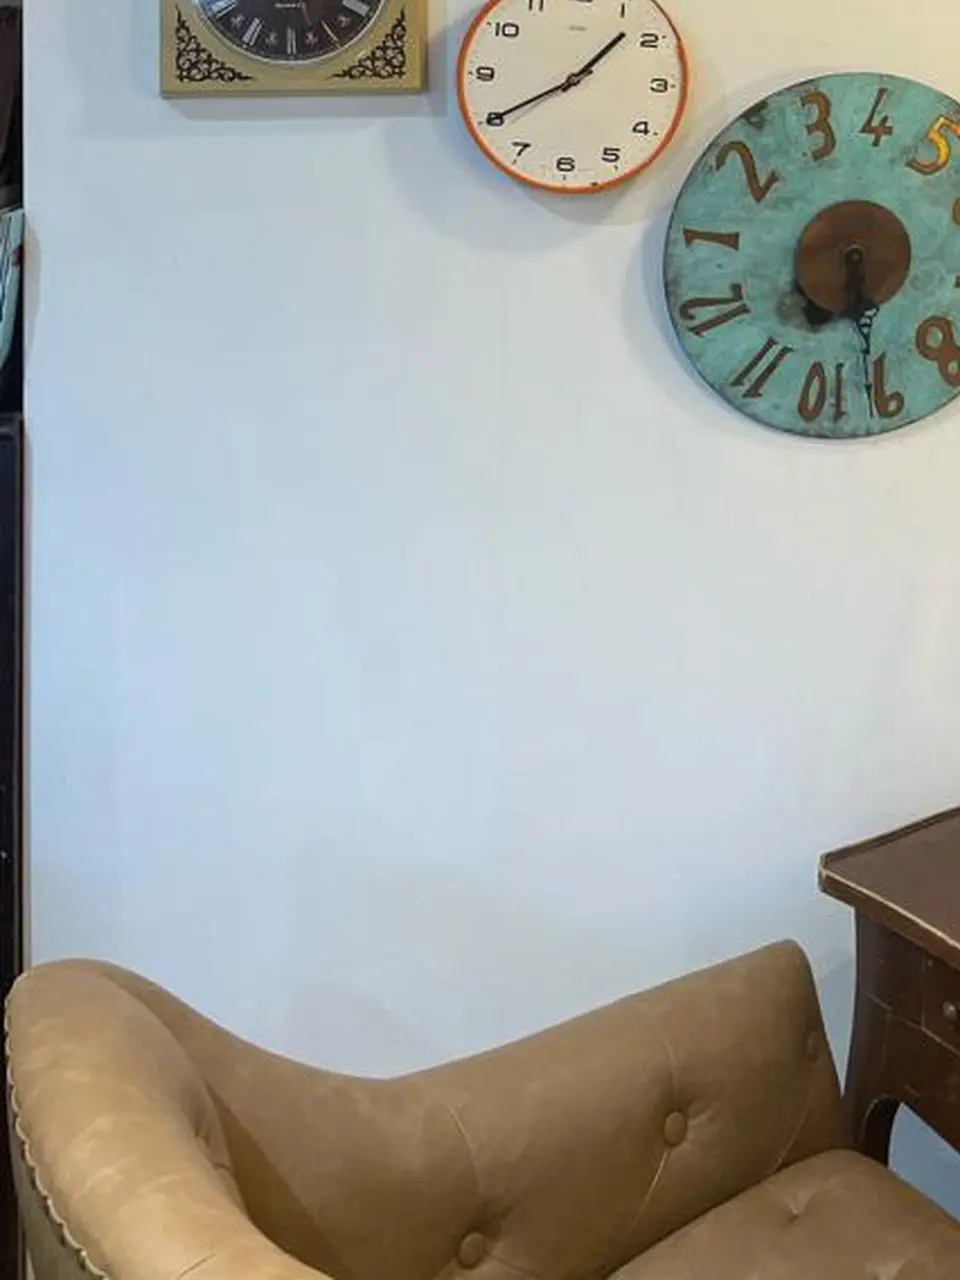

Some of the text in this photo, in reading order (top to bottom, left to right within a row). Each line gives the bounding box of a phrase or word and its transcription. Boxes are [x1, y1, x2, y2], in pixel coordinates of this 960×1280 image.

[619, 2, 627, 19] 1
[494, 22, 521, 38] 10
[639, 32, 660, 49] 2
[475, 66, 496, 82] 9
[649, 77, 669, 94] 3
[801, 89, 837, 162] 3
[859, 88, 893, 147] 4
[631, 120, 651, 136] 4
[511, 141, 532, 158] 7
[601, 147, 621, 164] 5
[556, 156, 576, 173] 6
[716, 141, 779, 202] 2
[683, 228, 739, 251] 1
[679, 282, 751, 337] 12
[731, 336, 795, 399] 11
[798, 361, 846, 423] 10
